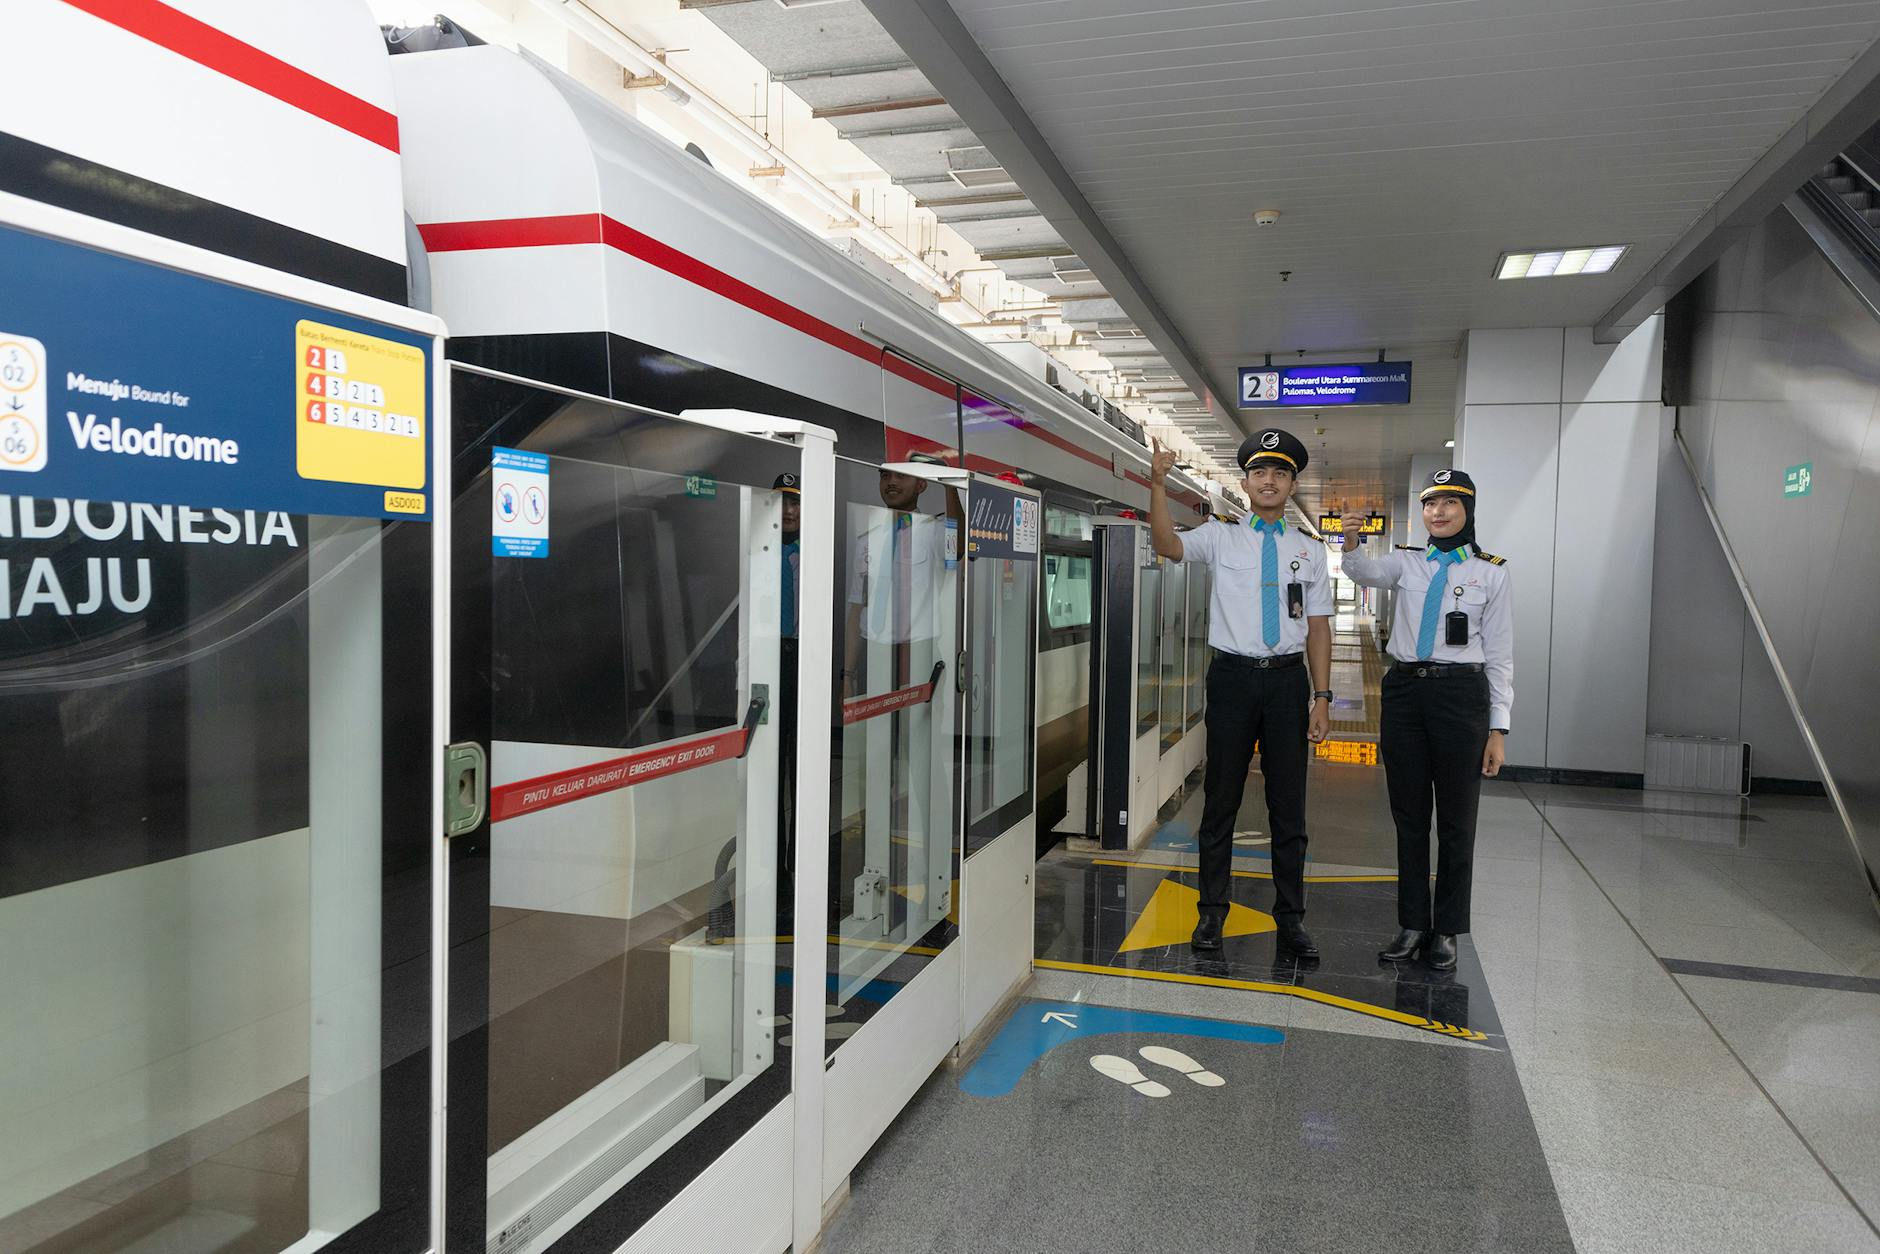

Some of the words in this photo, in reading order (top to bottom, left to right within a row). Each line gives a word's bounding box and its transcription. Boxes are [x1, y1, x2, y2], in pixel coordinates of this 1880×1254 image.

[310, 348, 321, 367] 2
[333, 354, 339, 370] 1
[3, 364, 24, 382] 02
[1283, 377, 1320, 386] Boulevard
[1321, 376, 1341, 385] Utara
[1342, 375, 1388, 384] Summarecon
[67, 371, 129, 401] Menuju
[131, 385, 170, 405] Bound
[172, 392, 190, 407] for
[310, 376, 322, 394] 4
[333, 380, 340, 396] 3
[353, 384, 360, 400] 2
[371, 388, 377, 403] 1
[1248, 376, 1261, 398] 2
[1283, 387, 1316, 396] Pulomas,
[1316, 386, 1356, 395] Velodrome
[310, 403, 322, 421] 6
[333, 407, 340, 423] 5
[352, 411, 360, 426] 4
[371, 413, 378, 429] 3
[390, 416, 397, 432] 2
[407, 420, 413, 434] 1
[4, 437, 26, 454] 06
[66, 411, 239, 465] Velodrome
[389, 496, 421, 510] ASD002
[0, 557, 152, 620] AJU
[522, 789, 550, 806] PINTU
[552, 780, 584, 797] KELUAR
[629, 754, 676, 776] EMERGENCY
[677, 750, 694, 764] EXIT
[695, 744, 716, 759] DOOR
